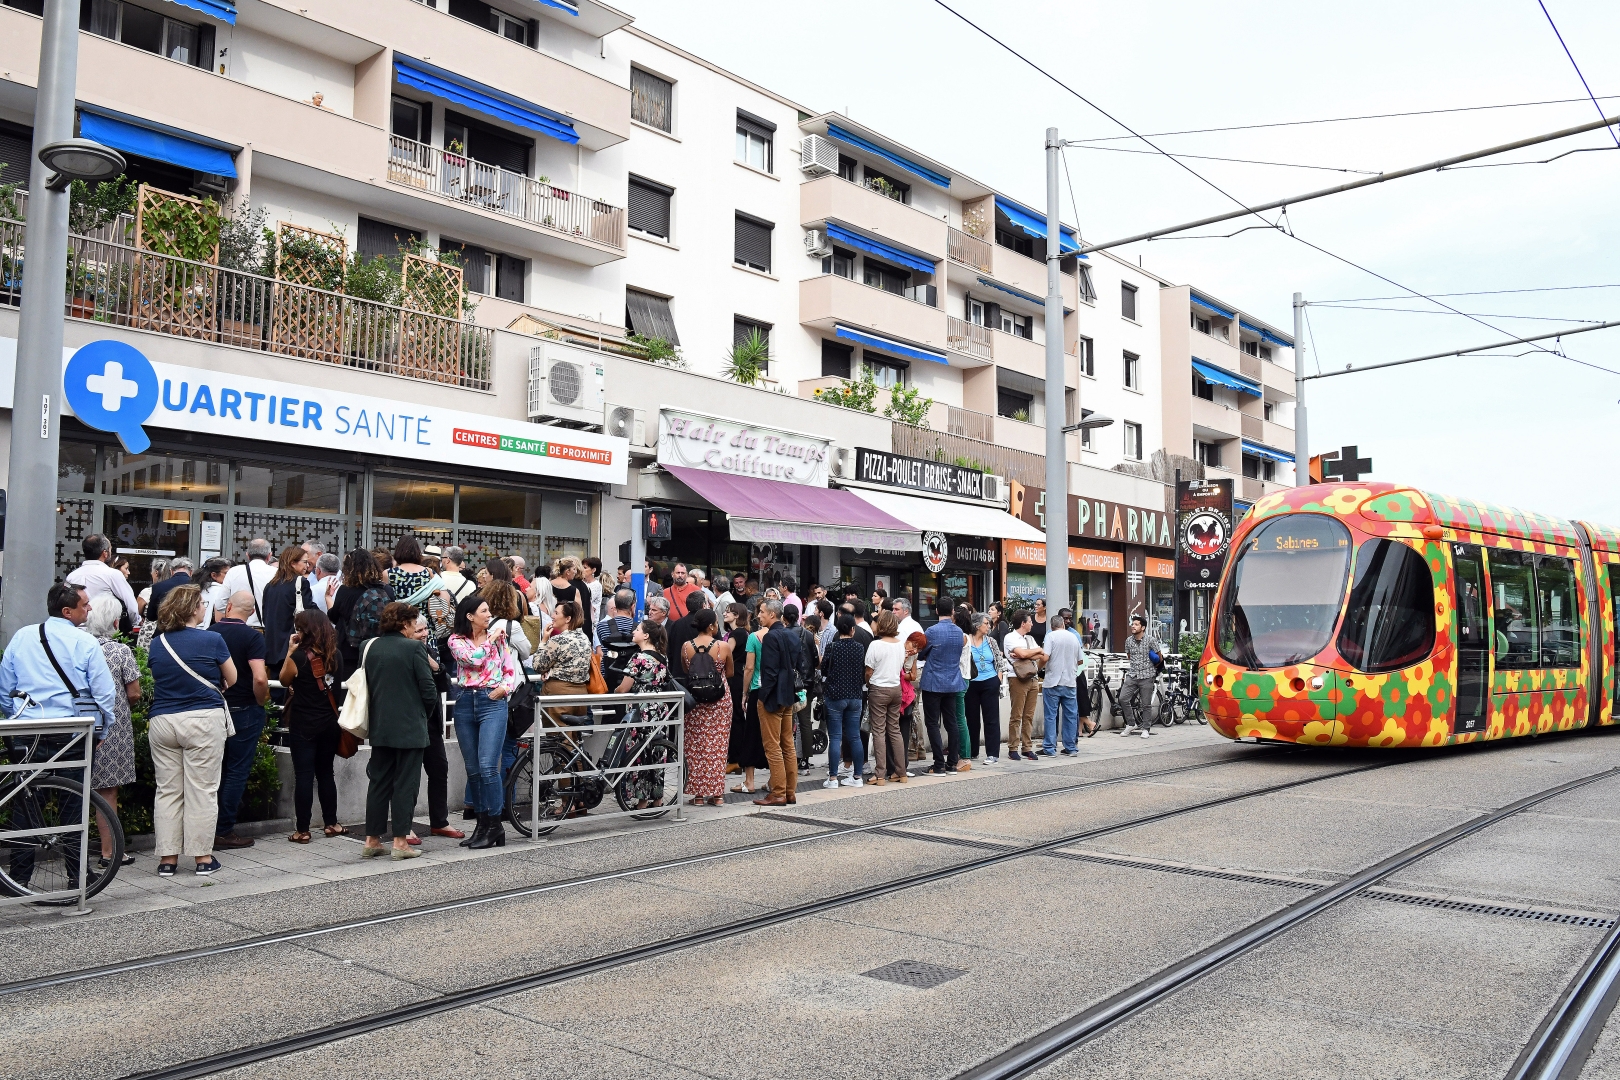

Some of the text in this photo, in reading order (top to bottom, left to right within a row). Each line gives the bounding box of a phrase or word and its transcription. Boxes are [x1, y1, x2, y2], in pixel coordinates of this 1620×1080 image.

[64, 339, 432, 455] QUARTIER SANTÉ
[455, 431, 610, 462] CENTRES DE SANTÉ DE PROXIMITÉ
[667, 417, 827, 464] Hair du Temps
[704, 449, 796, 479] Coiffure
[863, 452, 922, 486] PIZZA-POULET
[1078, 498, 1176, 547] PHARMA
[1180, 506, 1231, 530] POULET BRAISE
[1014, 545, 1046, 562] MATERIEL
[1082, 554, 1120, 569] ORTHOPEDIE
[1252, 536, 1319, 551] 2 Sabines
